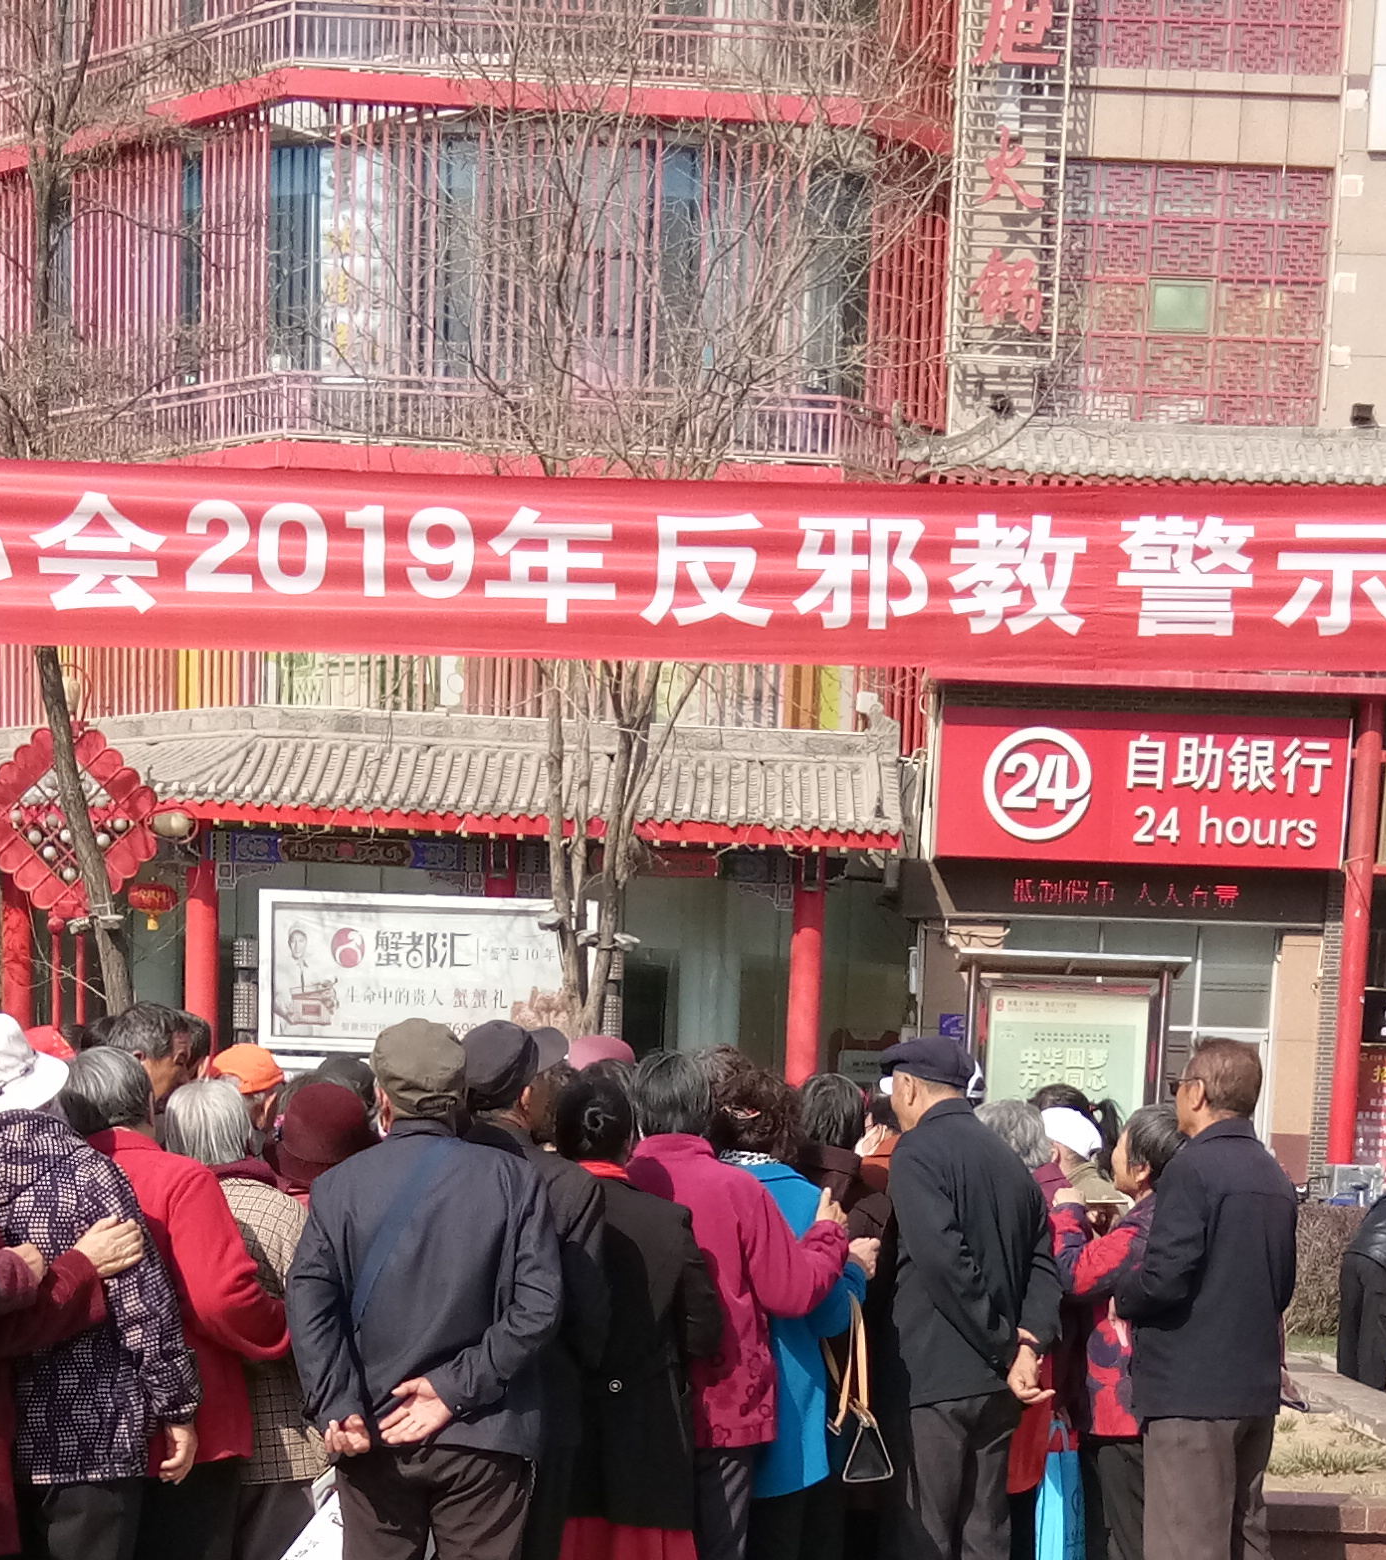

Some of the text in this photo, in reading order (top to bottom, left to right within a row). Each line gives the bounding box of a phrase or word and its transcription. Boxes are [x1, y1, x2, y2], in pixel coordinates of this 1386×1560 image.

[1001, 748, 1070, 811] 24
[1125, 733, 1333, 796] 自助银行
[1133, 803, 1318, 848] 24 hours
[1013, 878, 1240, 909] 抵制假币 人人有责
[375, 929, 473, 969] 蟹都汇
[347, 985, 509, 1010] 生命中的贵人 蟹蟹礼
